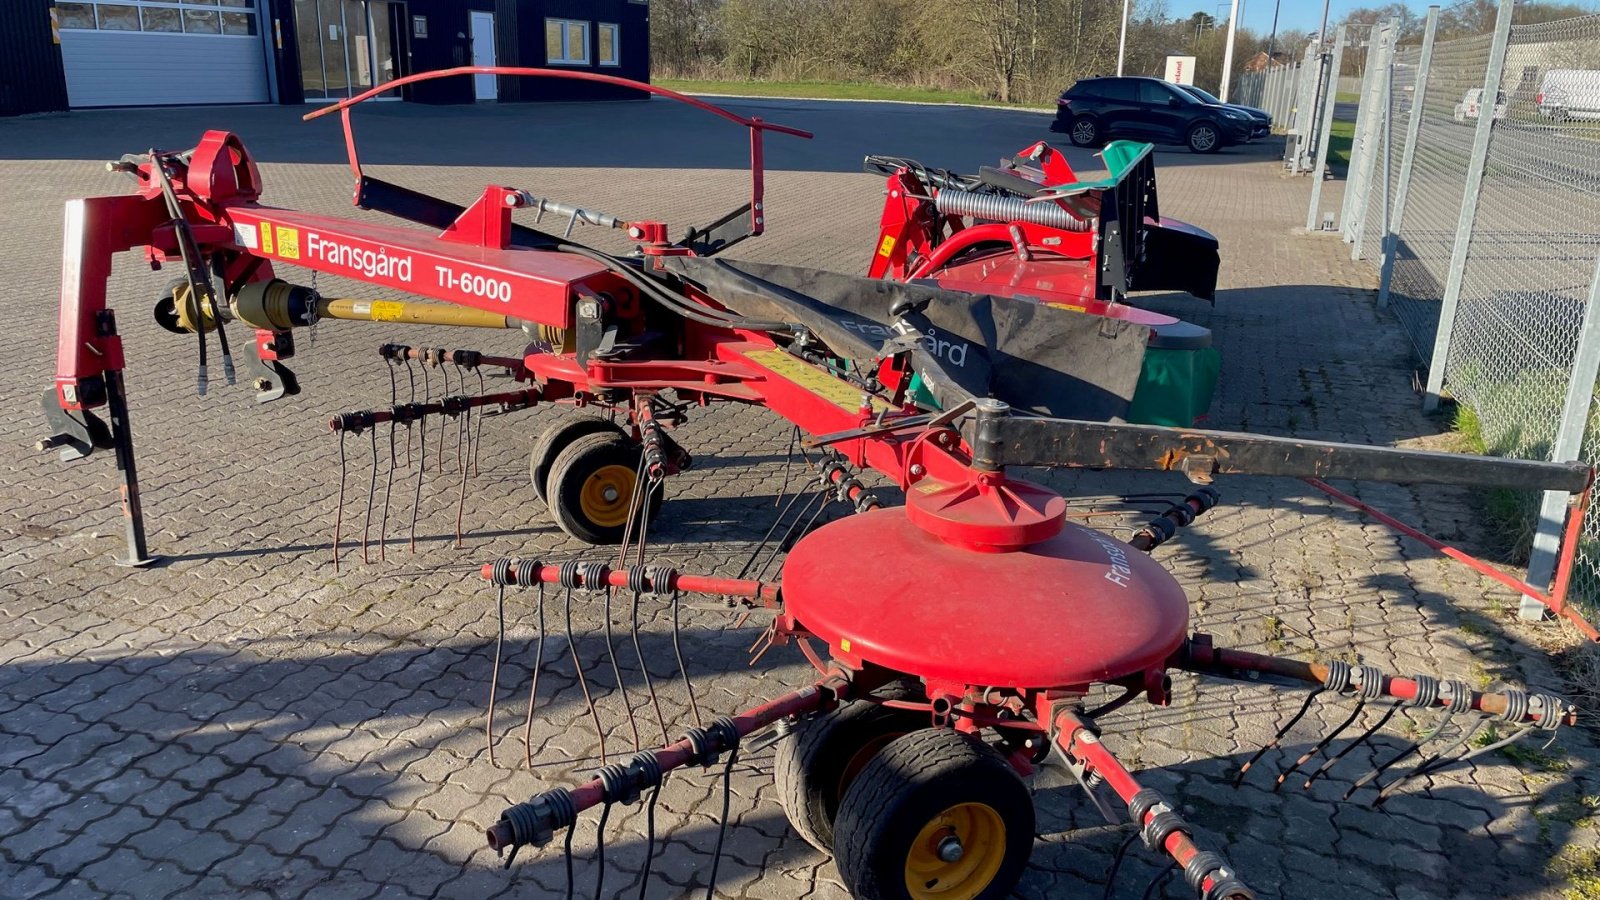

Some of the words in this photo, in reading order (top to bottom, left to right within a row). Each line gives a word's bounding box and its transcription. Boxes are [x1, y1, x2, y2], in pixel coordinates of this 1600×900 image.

[307, 233, 413, 282] Fransgård
[435, 266, 512, 303] TI-6000
[840, 318, 969, 368] Fransård
